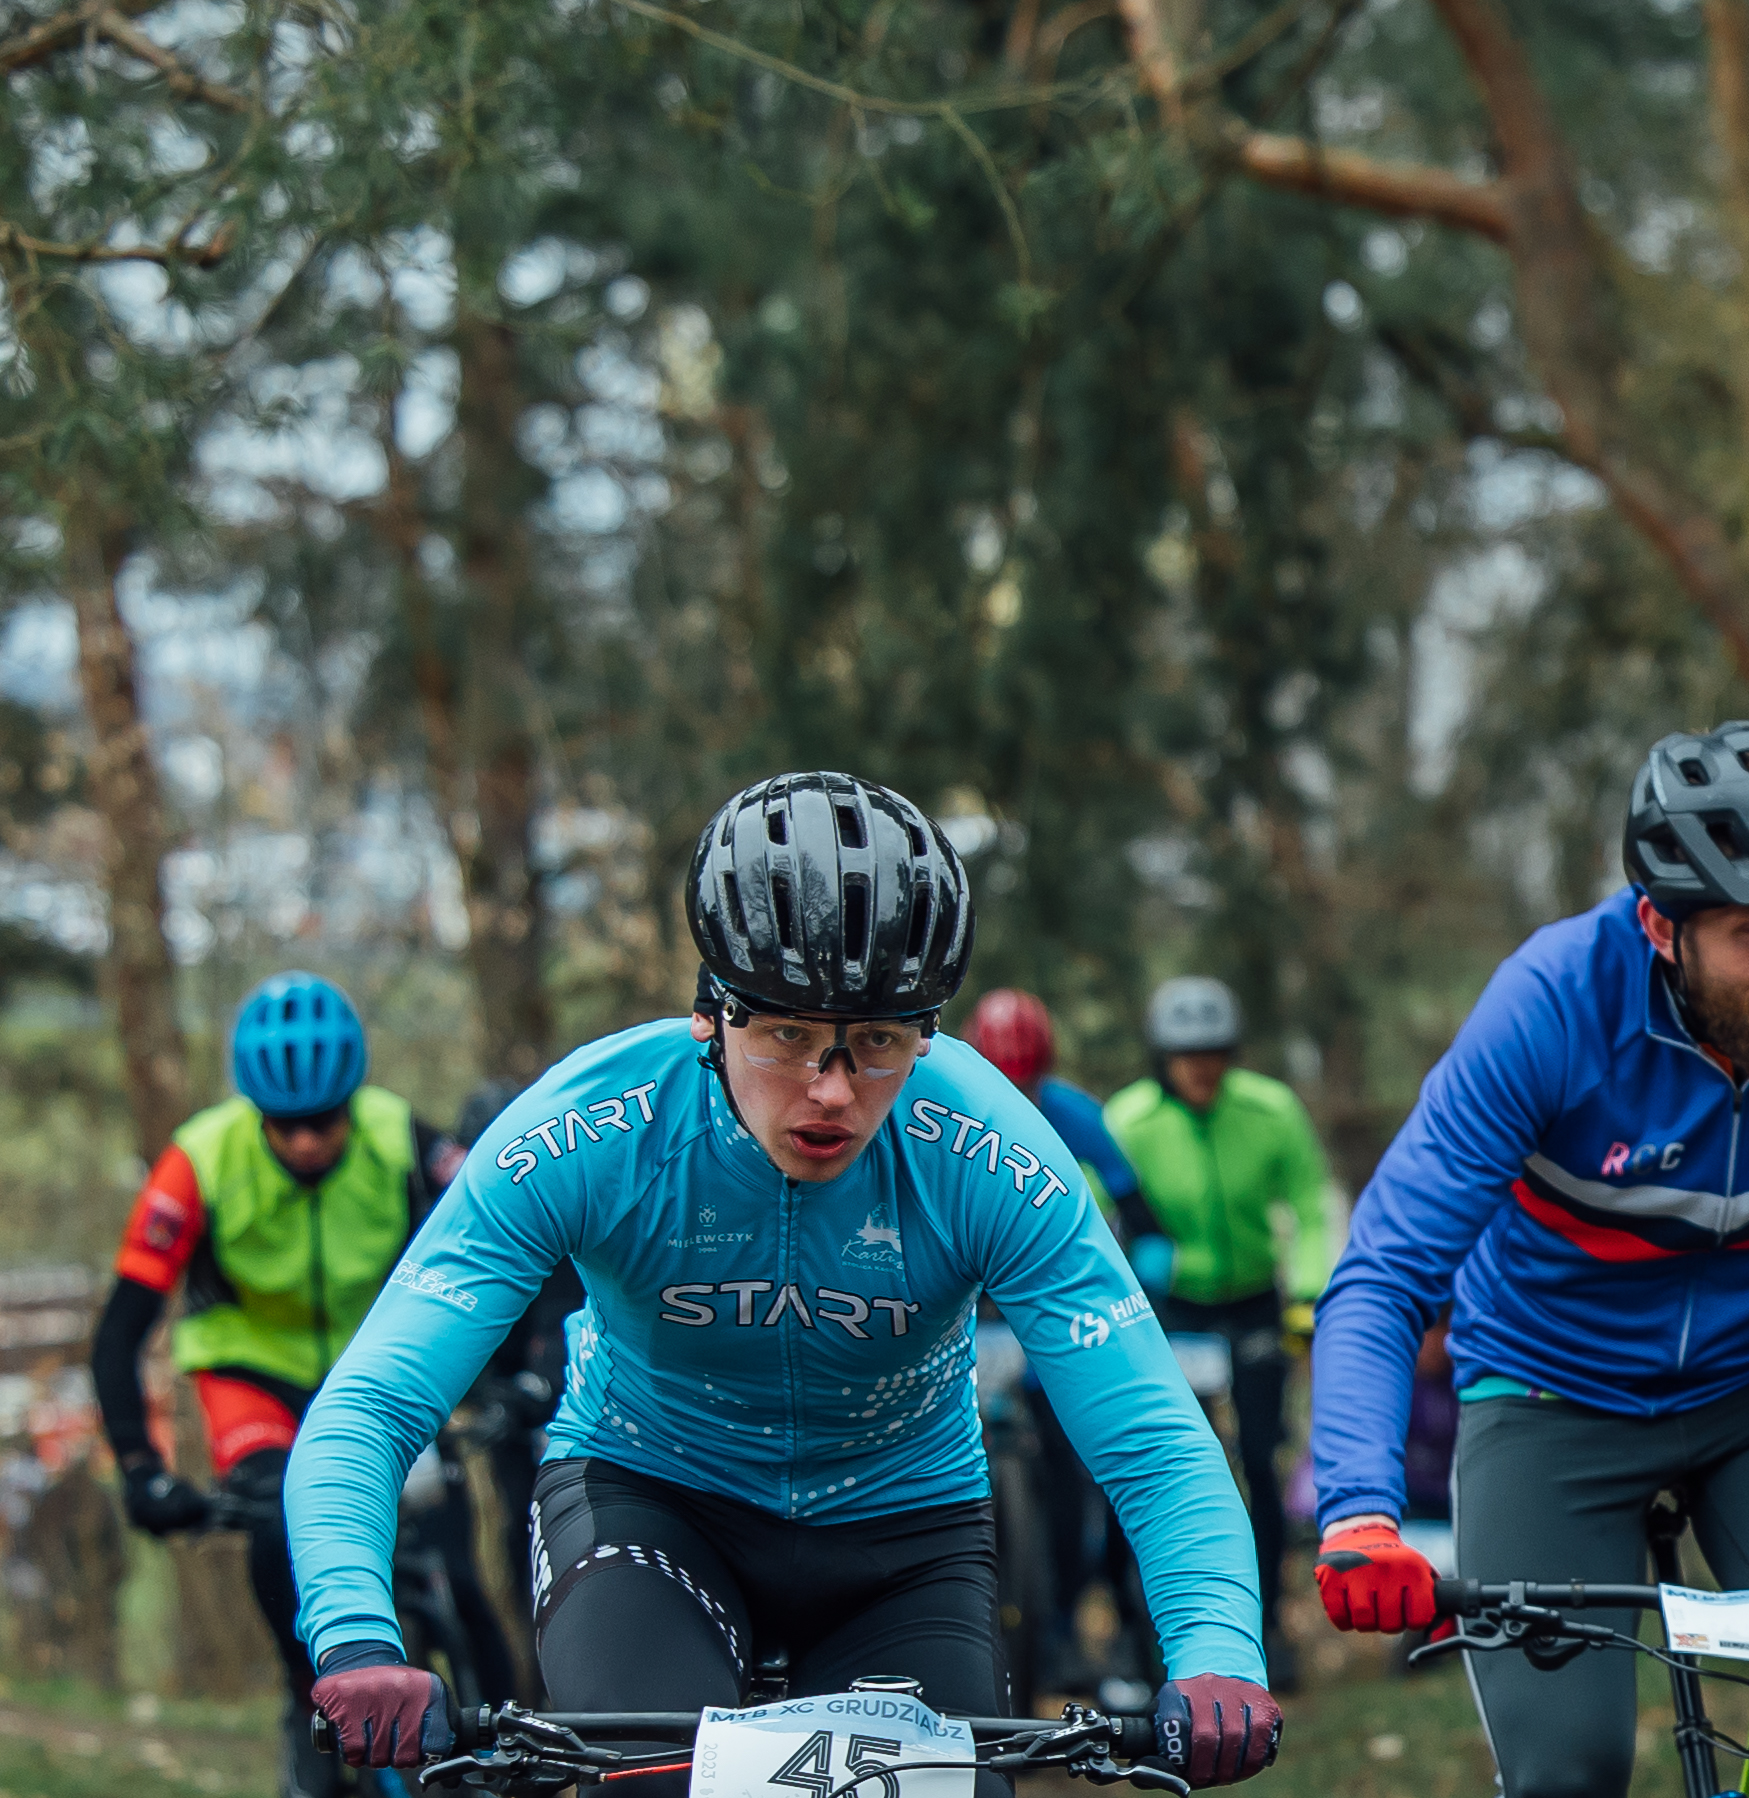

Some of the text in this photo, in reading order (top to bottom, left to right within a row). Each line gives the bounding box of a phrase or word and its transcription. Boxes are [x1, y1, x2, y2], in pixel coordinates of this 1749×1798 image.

[496, 1079, 657, 1186] START
[905, 1098, 1069, 1209] START
[667, 1233, 754, 1248] MIELEWCZYK
[660, 1279, 922, 1341] START
[710, 1709, 768, 1723] MTB
[779, 1702, 814, 1716] XC
[702, 1743, 718, 1779] 2023
